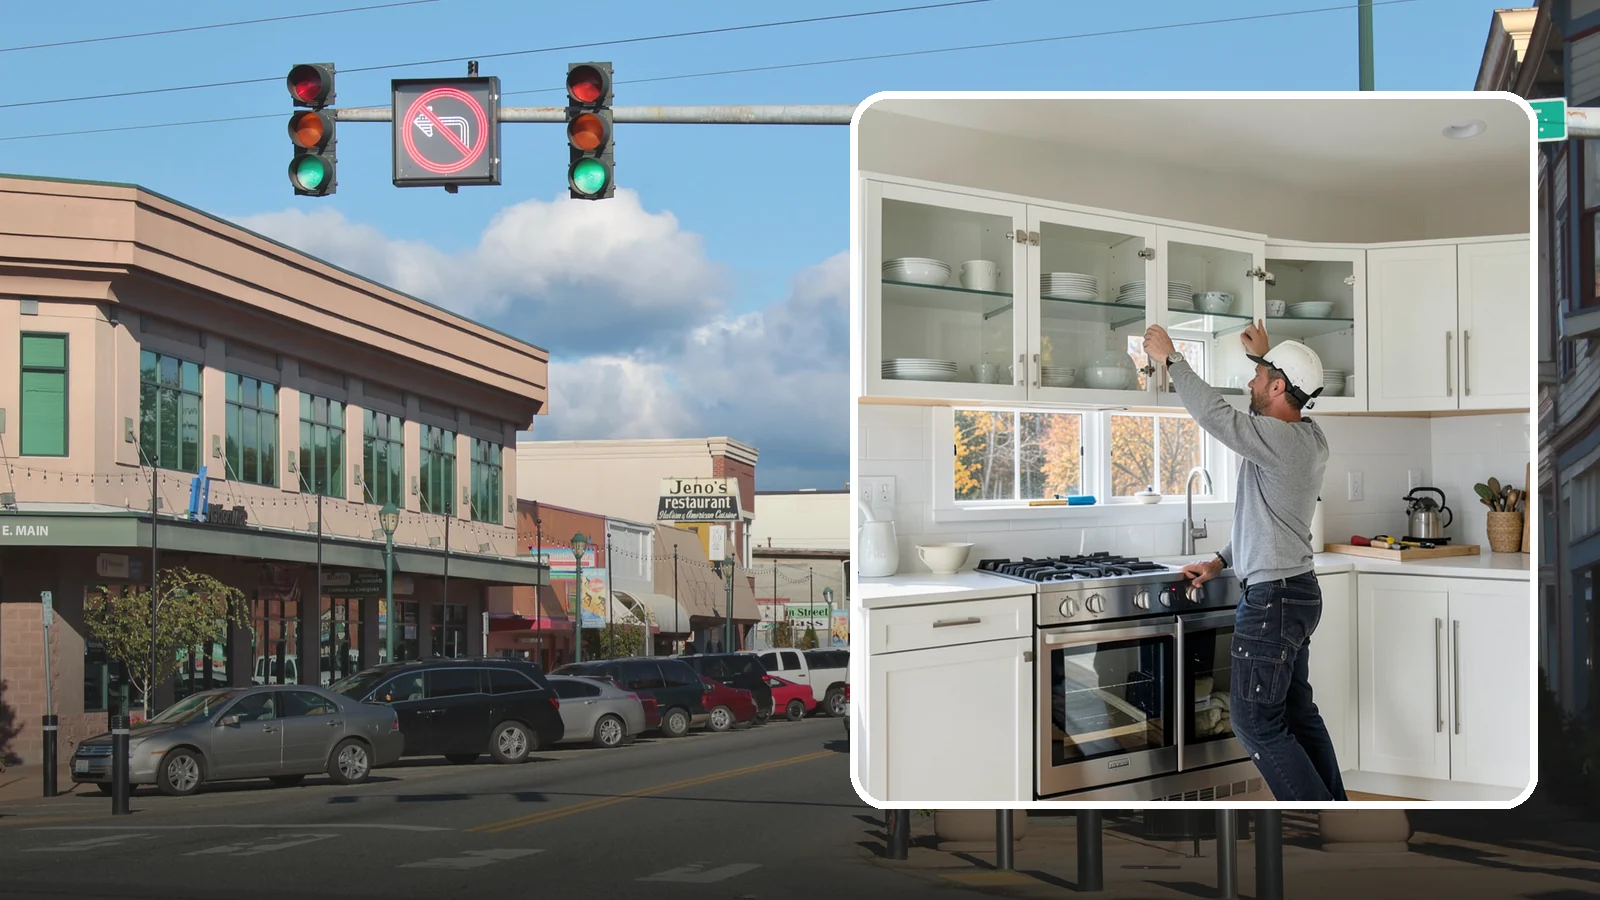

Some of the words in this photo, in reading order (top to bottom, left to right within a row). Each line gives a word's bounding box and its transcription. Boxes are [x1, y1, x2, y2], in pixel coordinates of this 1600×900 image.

[670, 480, 727, 494] Jeno's
[665, 496, 731, 509] restaurant
[659, 509, 680, 519] Italian
[686, 509, 715, 519] American
[715, 509, 737, 519] Cuisine
[2, 525, 13, 536] E.
[15, 525, 49, 536] MAIN
[797, 607, 828, 617] Street
